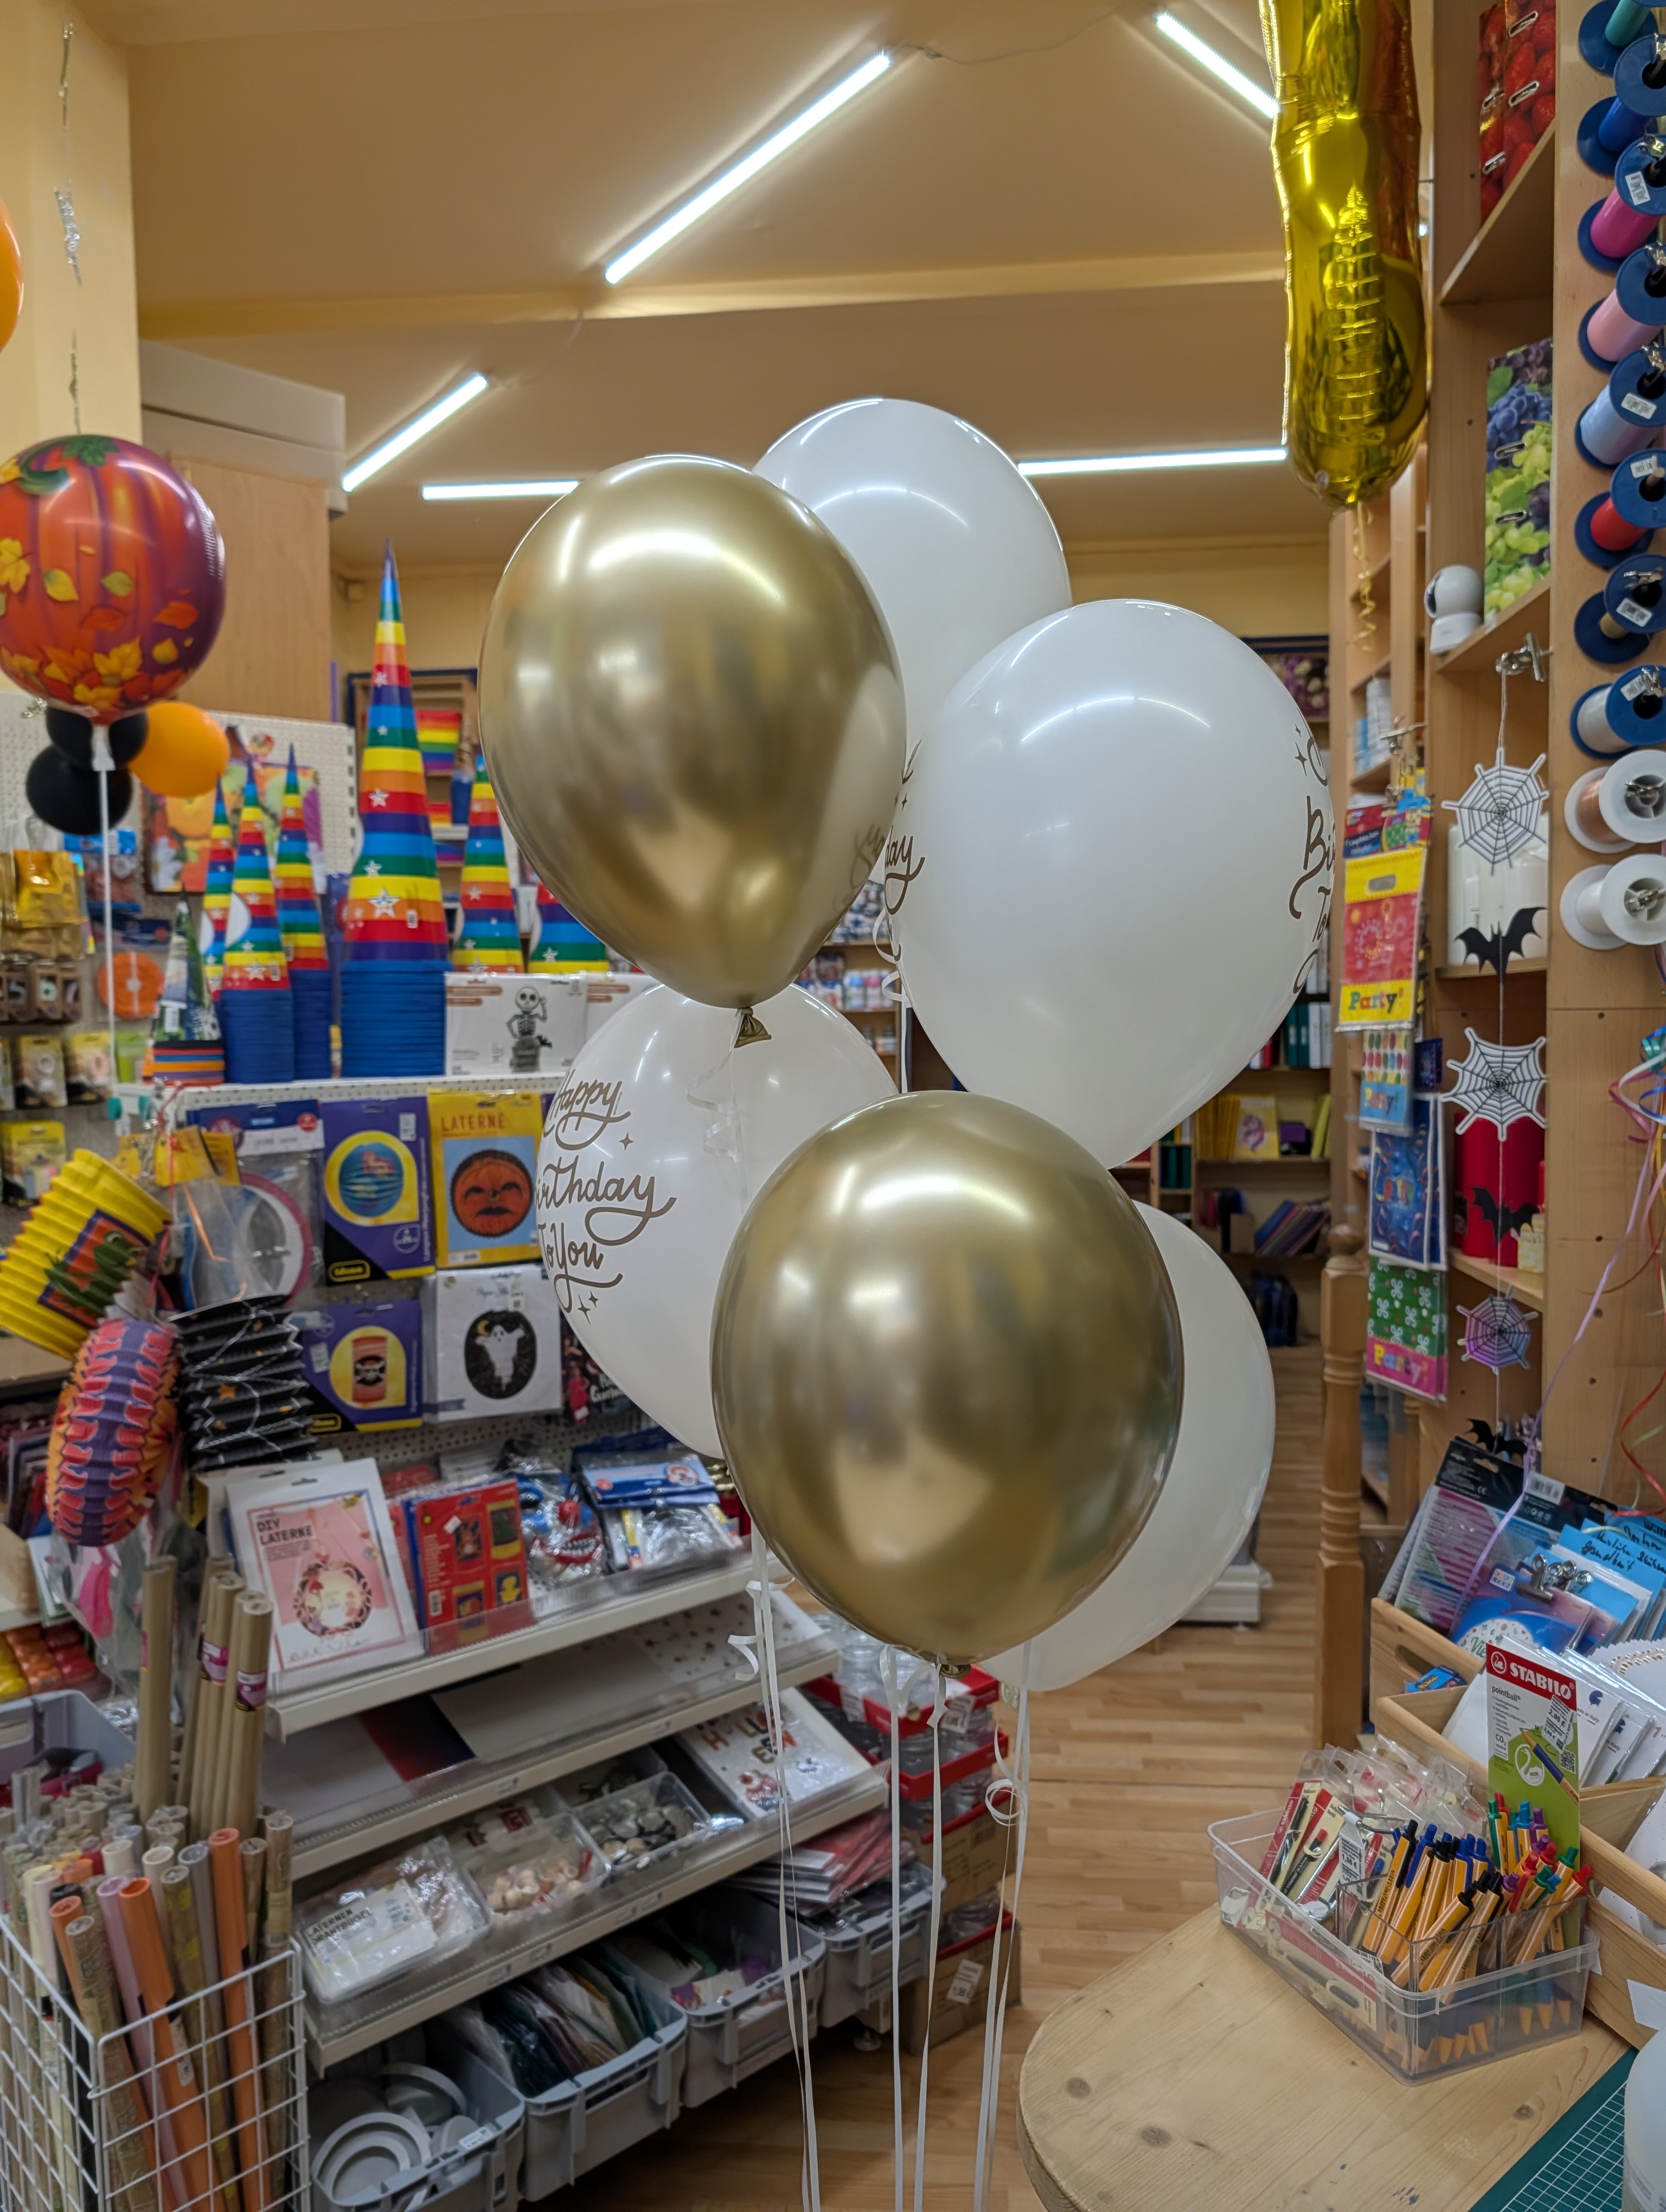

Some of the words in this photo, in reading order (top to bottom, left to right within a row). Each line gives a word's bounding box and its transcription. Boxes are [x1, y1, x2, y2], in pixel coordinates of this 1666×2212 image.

[543, 1069, 631, 1150] Happy
[441, 1113, 505, 1132] LATERNE
[533, 1155, 677, 1246] irthday
[550, 1222, 624, 1314] You
[256, 1517, 281, 1533] DIY
[259, 1525, 313, 1546] LATERNE
[1590, 1713, 1599, 1724] Italy
